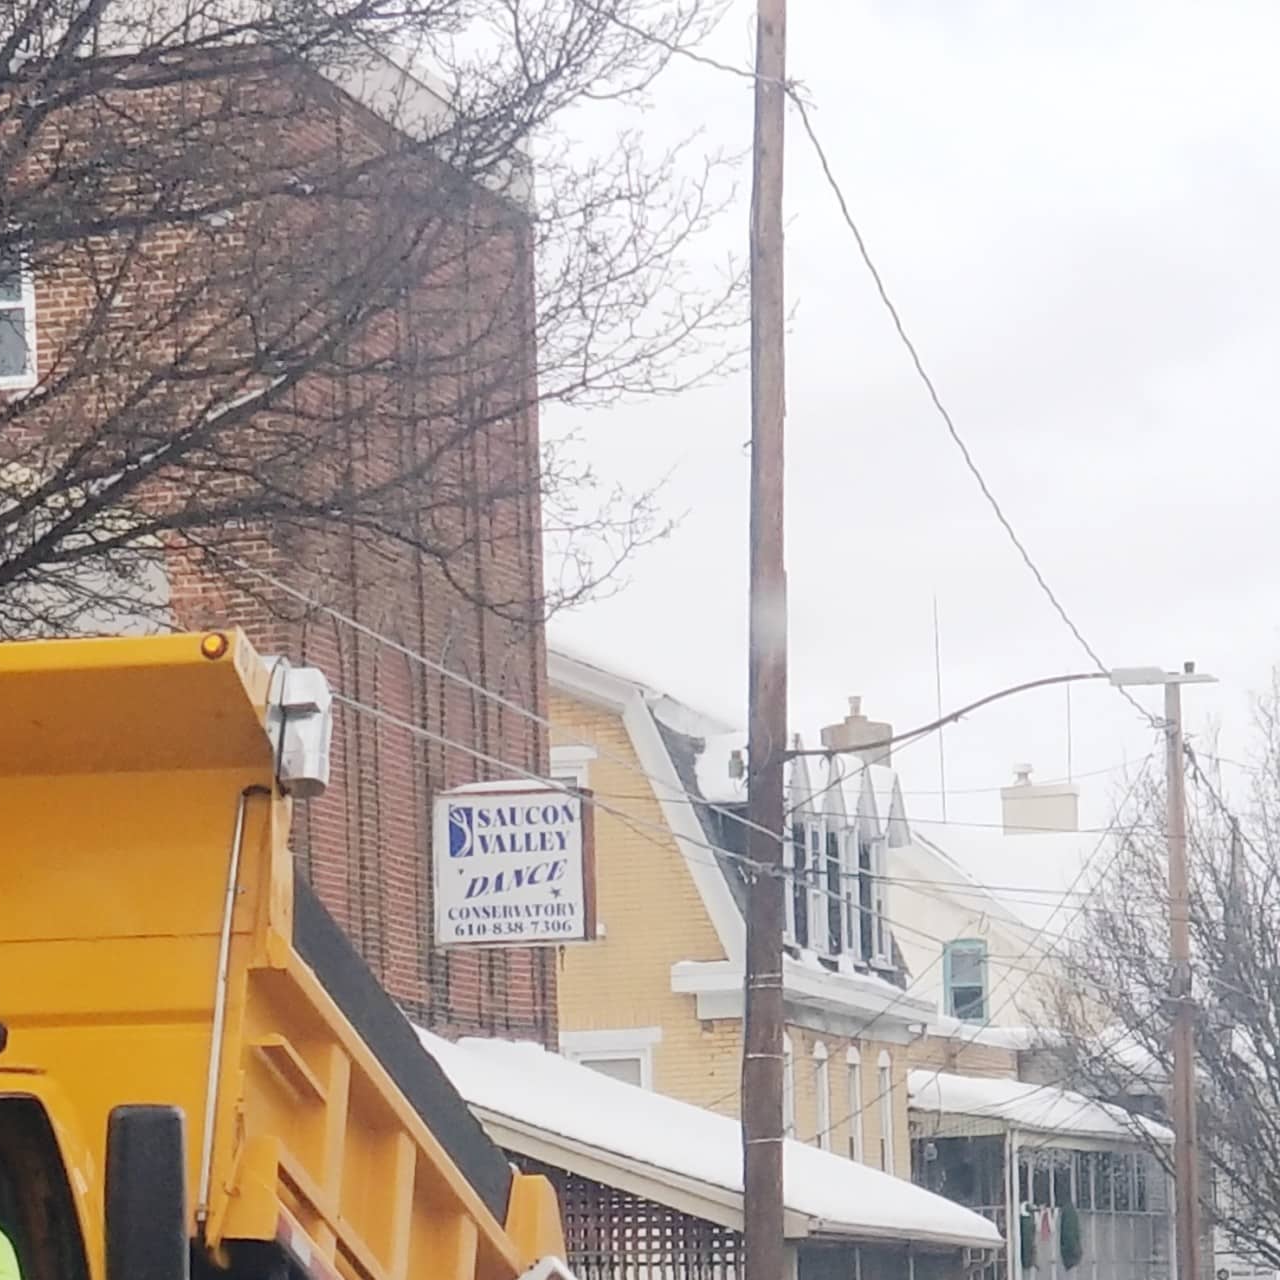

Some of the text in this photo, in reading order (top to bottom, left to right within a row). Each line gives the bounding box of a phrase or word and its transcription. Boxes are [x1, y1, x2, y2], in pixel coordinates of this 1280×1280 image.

[477, 804, 576, 828] SAUCON
[477, 831, 570, 854] VALLEY
[464, 858, 568, 899] DANCE
[448, 903, 577, 921] CONSERVATORY
[454, 919, 572, 936] 610-838-7306
